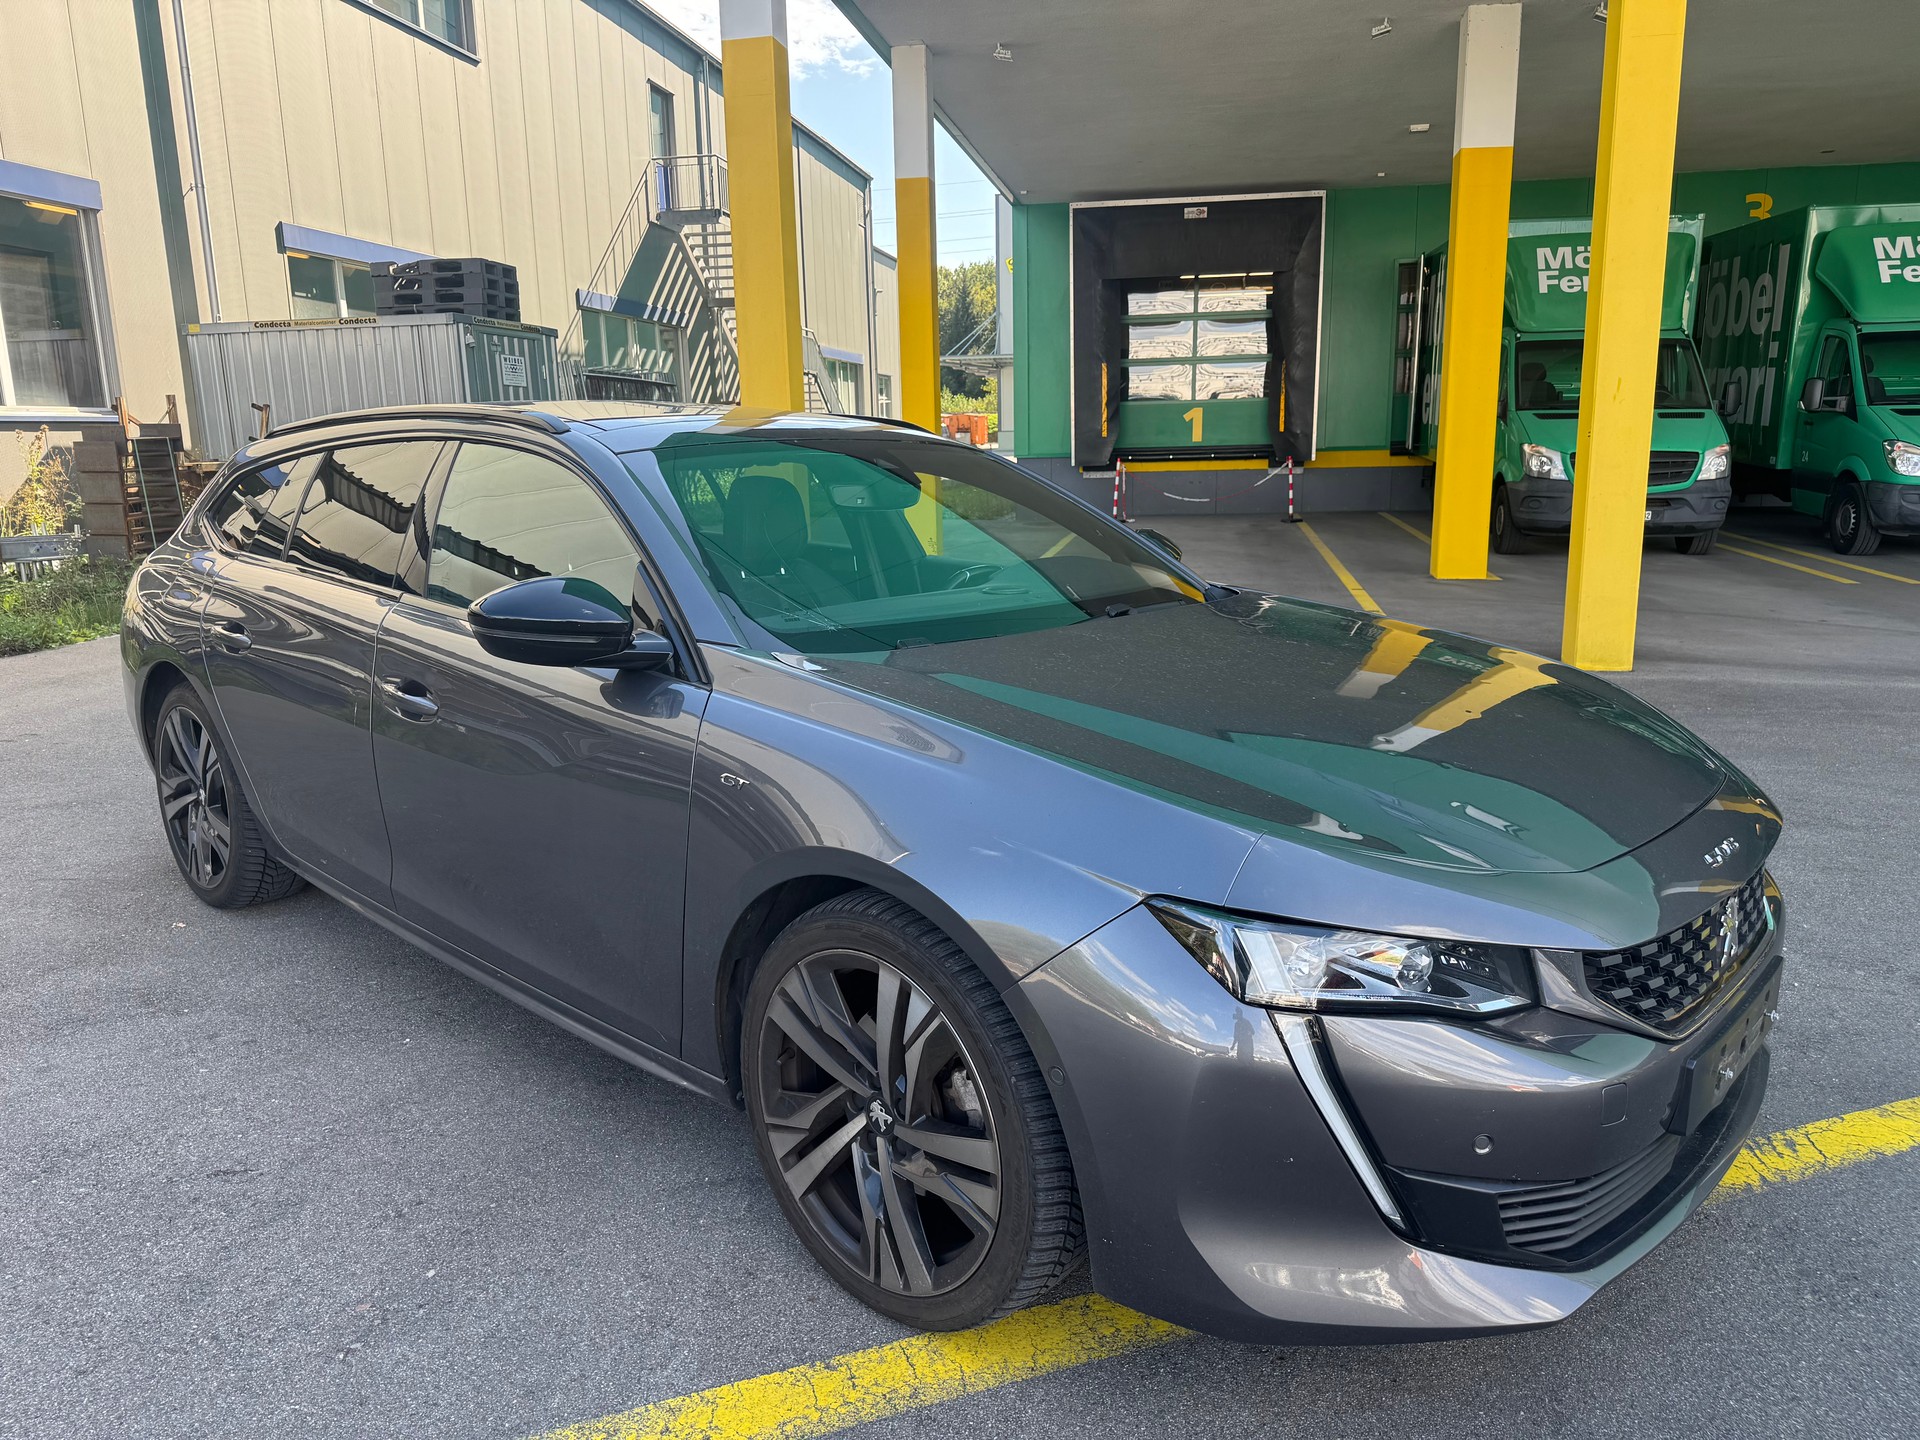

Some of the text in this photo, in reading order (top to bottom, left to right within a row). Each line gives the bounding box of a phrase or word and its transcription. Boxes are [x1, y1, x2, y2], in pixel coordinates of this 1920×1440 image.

[1746, 193, 1773, 220] 3
[1536, 246, 1591, 269] Mö
[1878, 260, 1920, 283] Fe
[338, 317, 377, 325] Condecta
[473, 317, 496, 326] Condecta
[1183, 407, 1203, 442] 1
[1801, 450, 1809, 462] 24
[720, 772, 750, 790] GT
[1703, 837, 1739, 868] 508
